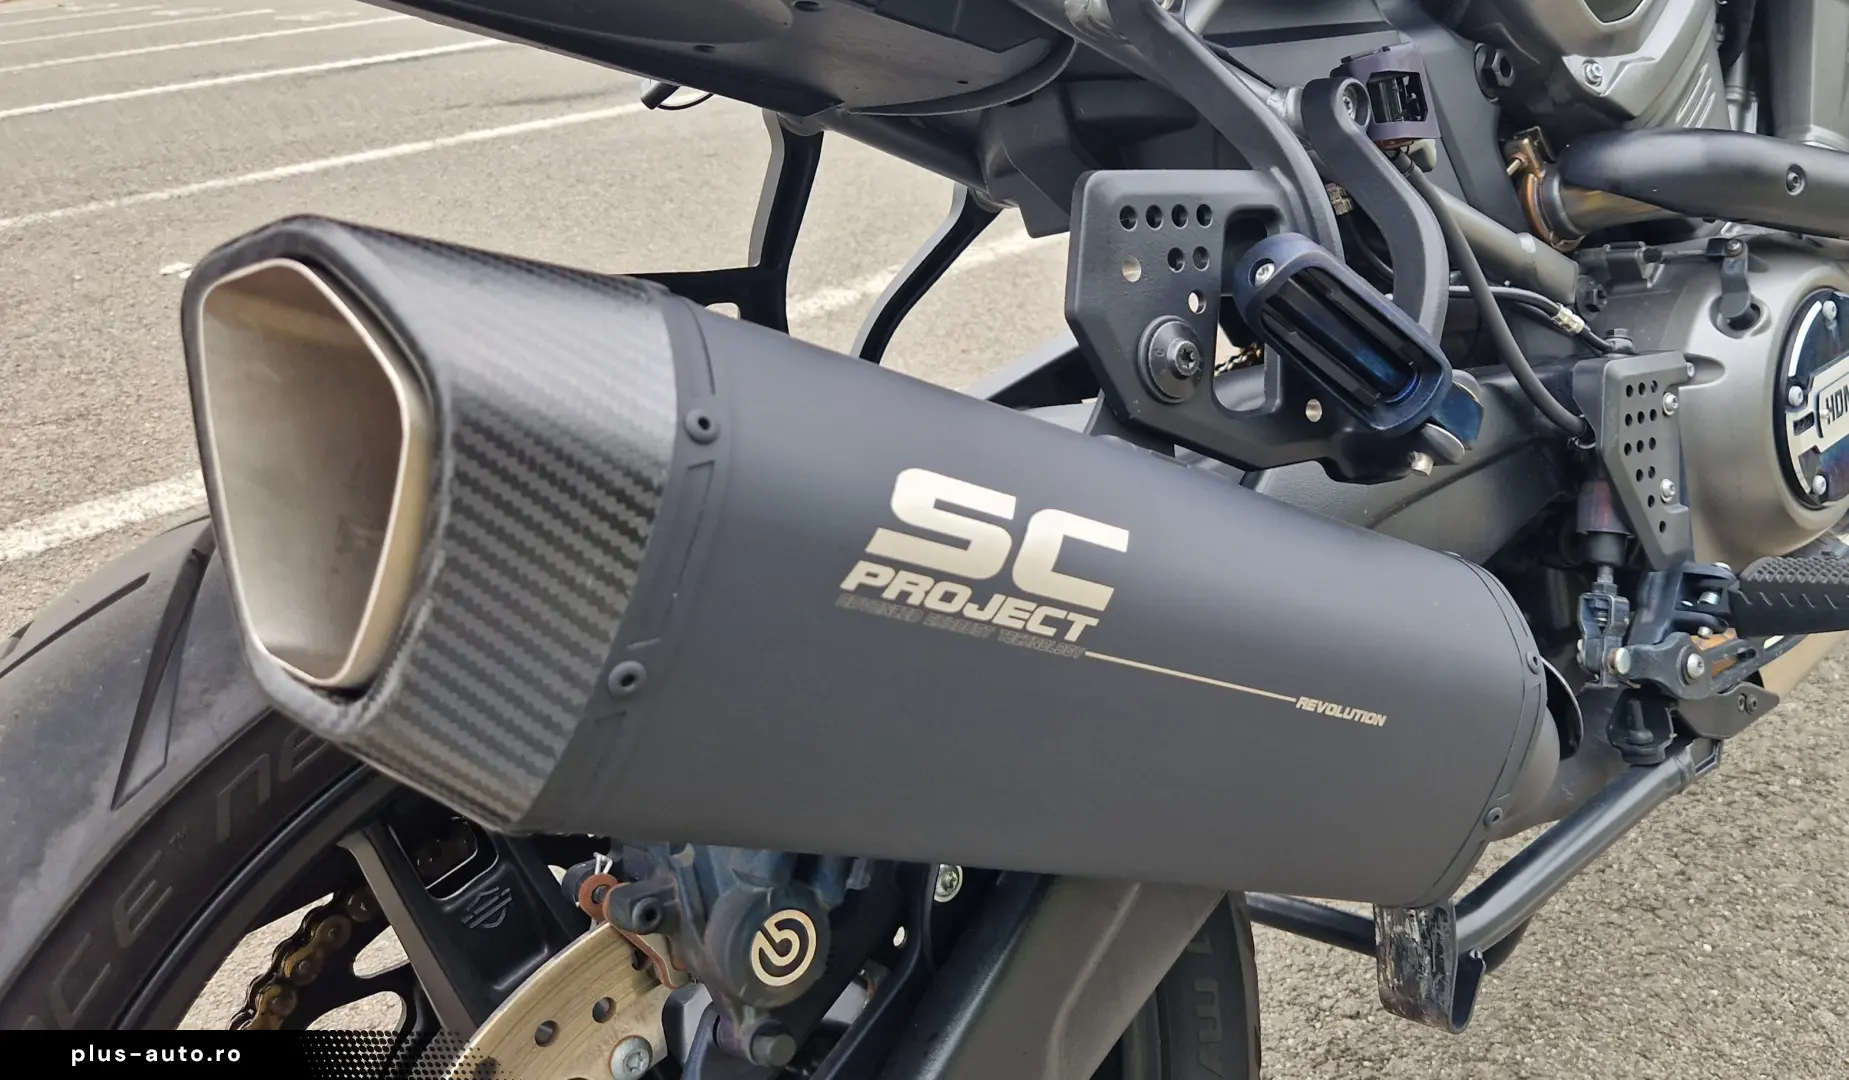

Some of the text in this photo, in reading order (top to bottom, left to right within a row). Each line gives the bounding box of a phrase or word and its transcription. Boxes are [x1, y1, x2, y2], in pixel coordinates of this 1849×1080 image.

[864, 467, 1130, 612] SC
[840, 560, 1099, 642] PROJECT
[1296, 696, 1387, 727] REVOLUTION
